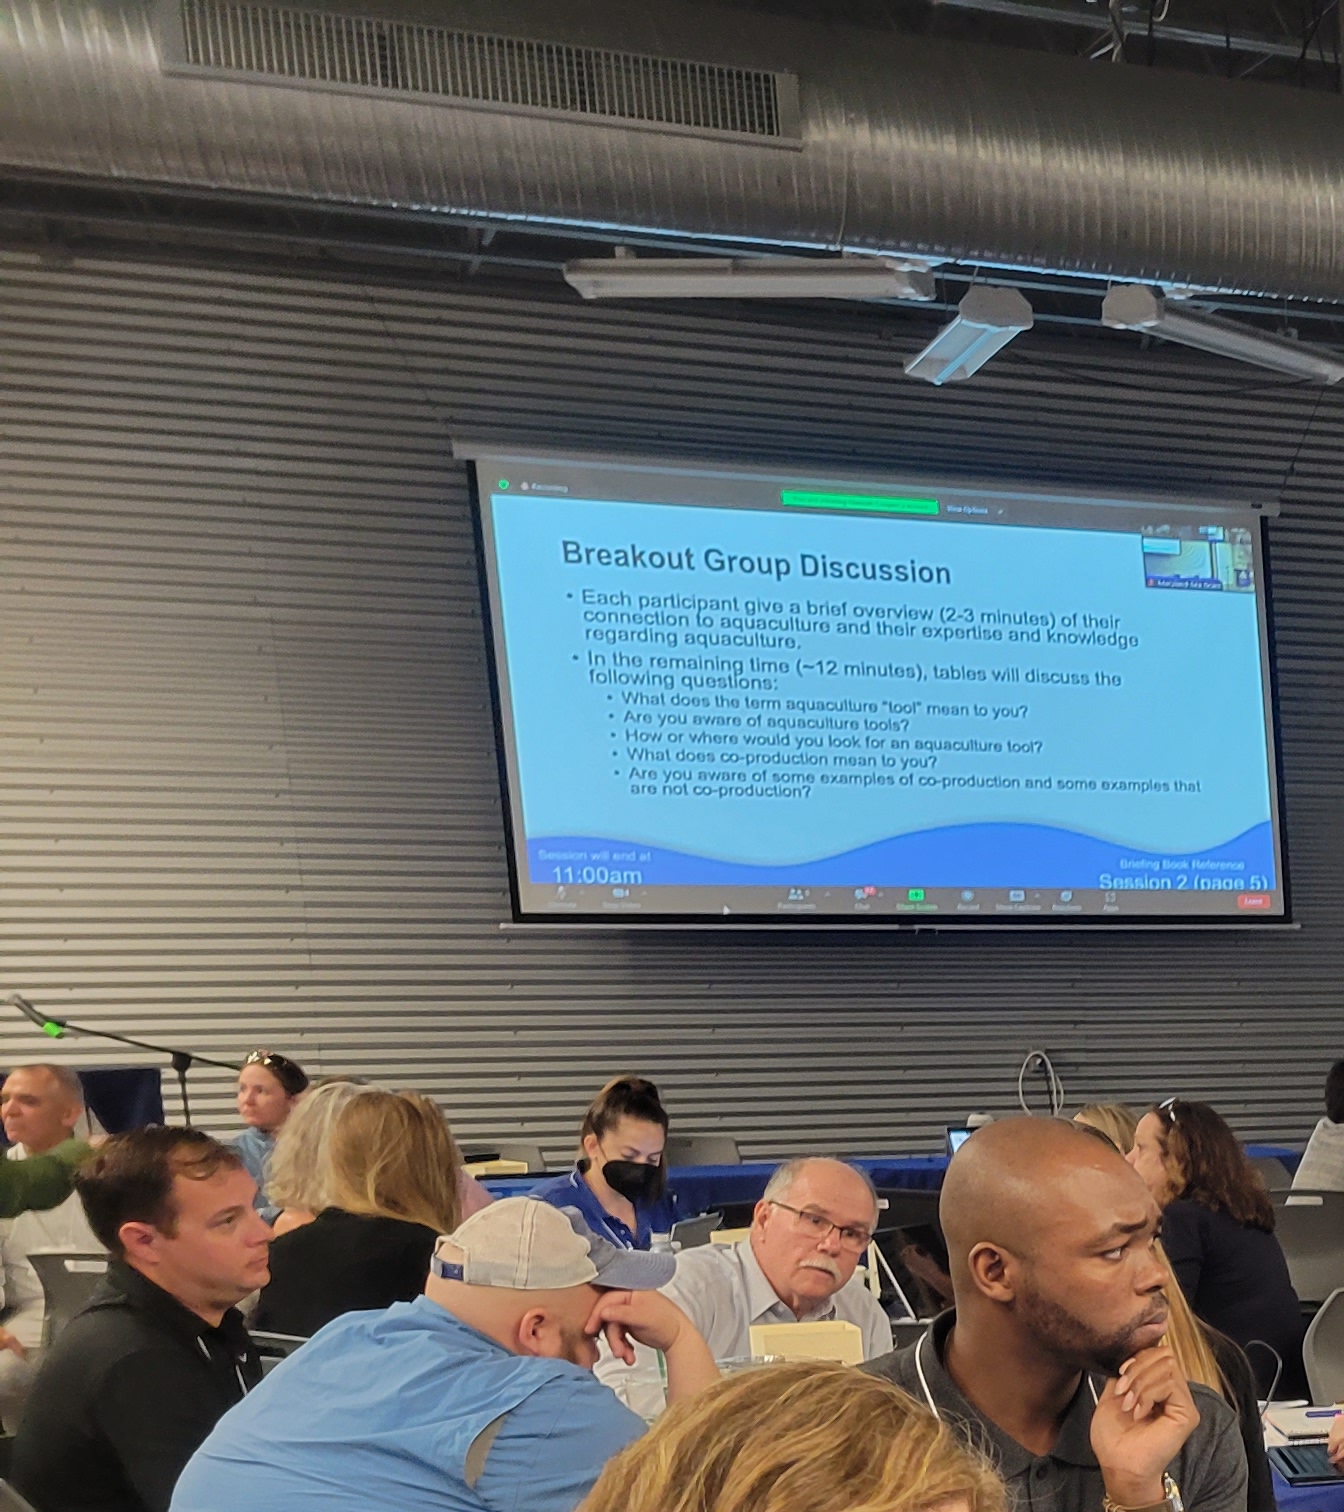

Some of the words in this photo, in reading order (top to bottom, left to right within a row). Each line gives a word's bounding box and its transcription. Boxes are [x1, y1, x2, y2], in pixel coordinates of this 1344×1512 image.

[562, 540, 695, 570] Breakout
[704, 548, 791, 581] Group
[800, 553, 951, 584] Discussion
[582, 588, 632, 606] Each
[638, 591, 740, 615] participant
[745, 598, 783, 616] give
[789, 602, 800, 614] a
[807, 600, 848, 617] brief
[853, 604, 934, 621] overview
[940, 607, 975, 624] (2-3
[980, 609, 1056, 630] minutes)
[1061, 612, 1077, 628] of
[1082, 613, 1121, 630] their
[583, 610, 690, 627] connection
[697, 612, 714, 628] to
[720, 616, 830, 633] aquaculture
[837, 621, 871, 636] and
[876, 621, 917, 637] their
[922, 626, 1003, 641] expertise
[1008, 628, 1041, 643] and
[1047, 630, 1139, 650] knowledge
[585, 627, 678, 648] regarding
[684, 632, 802, 649] aquaculture.
[588, 650, 606, 667] In
[613, 651, 642, 668] the
[650, 655, 743, 676] remaining
[750, 656, 790, 673] time
[796, 658, 838, 677] (~12
[844, 661, 928, 682] minutes),
[933, 664, 987, 682] tables
[992, 667, 1019, 684] will
[1025, 668, 1090, 686] discuss
[1095, 670, 1122, 687] the
[589, 668, 675, 690] following
[681, 673, 778, 691] questions:
[621, 691, 666, 706] What
[671, 692, 710, 708] does
[714, 695, 740, 709] the
[745, 696, 781, 711] term
[786, 698, 878, 714] aquaculture
[926, 703, 969, 716] mean
[975, 703, 988, 717] to
[992, 704, 1029, 721] you?
[624, 710, 652, 724] Are
[657, 713, 688, 728] you
[693, 714, 742, 727] aware
[746, 714, 762, 728] of
[767, 716, 859, 731] aquaculture
[864, 718, 910, 732] tools?
[625, 728, 662, 743] How
[667, 731, 684, 743] or
[689, 730, 738, 745] where
[743, 733, 790, 746] would
[795, 736, 823, 750] you
[828, 734, 861, 748] look
[865, 735, 886, 749] for
[890, 739, 910, 750] an
[914, 739, 1002, 754] aquaculture
[1007, 741, 1043, 754] tool?
[626, 746, 671, 762] What
[675, 748, 715, 763] does
[720, 751, 828, 767] co-production
[833, 755, 877, 768] mean
[881, 754, 896, 768] to
[901, 755, 938, 771] you?
[629, 766, 658, 781] Are
[663, 769, 692, 784] you
[697, 770, 747, 782] aware
[751, 769, 767, 783] of
[772, 772, 815, 785] some
[820, 773, 896, 788] examples
[899, 773, 913, 787] of
[919, 774, 1020, 789] co-production
[1025, 776, 1052, 790] and
[1057, 778, 1097, 791] some
[1101, 779, 1170, 794] examples
[1174, 779, 1201, 793] that
[630, 783, 657, 795] are
[662, 783, 689, 796] not
[693, 784, 812, 798] co-production?
[538, 849, 587, 860] Session
[591, 850, 610, 861] will
[613, 850, 636, 861] end
[639, 851, 651, 862] at
[1120, 859, 1160, 871] Briefing
[1162, 859, 1189, 870] Book
[1192, 860, 1245, 871] Reference
[553, 866, 643, 884] 11:00am
[1099, 873, 1171, 890] Session
[1176, 874, 1188, 890] 2
[1194, 874, 1245, 890] (page
[1250, 875, 1268, 890] 5)
